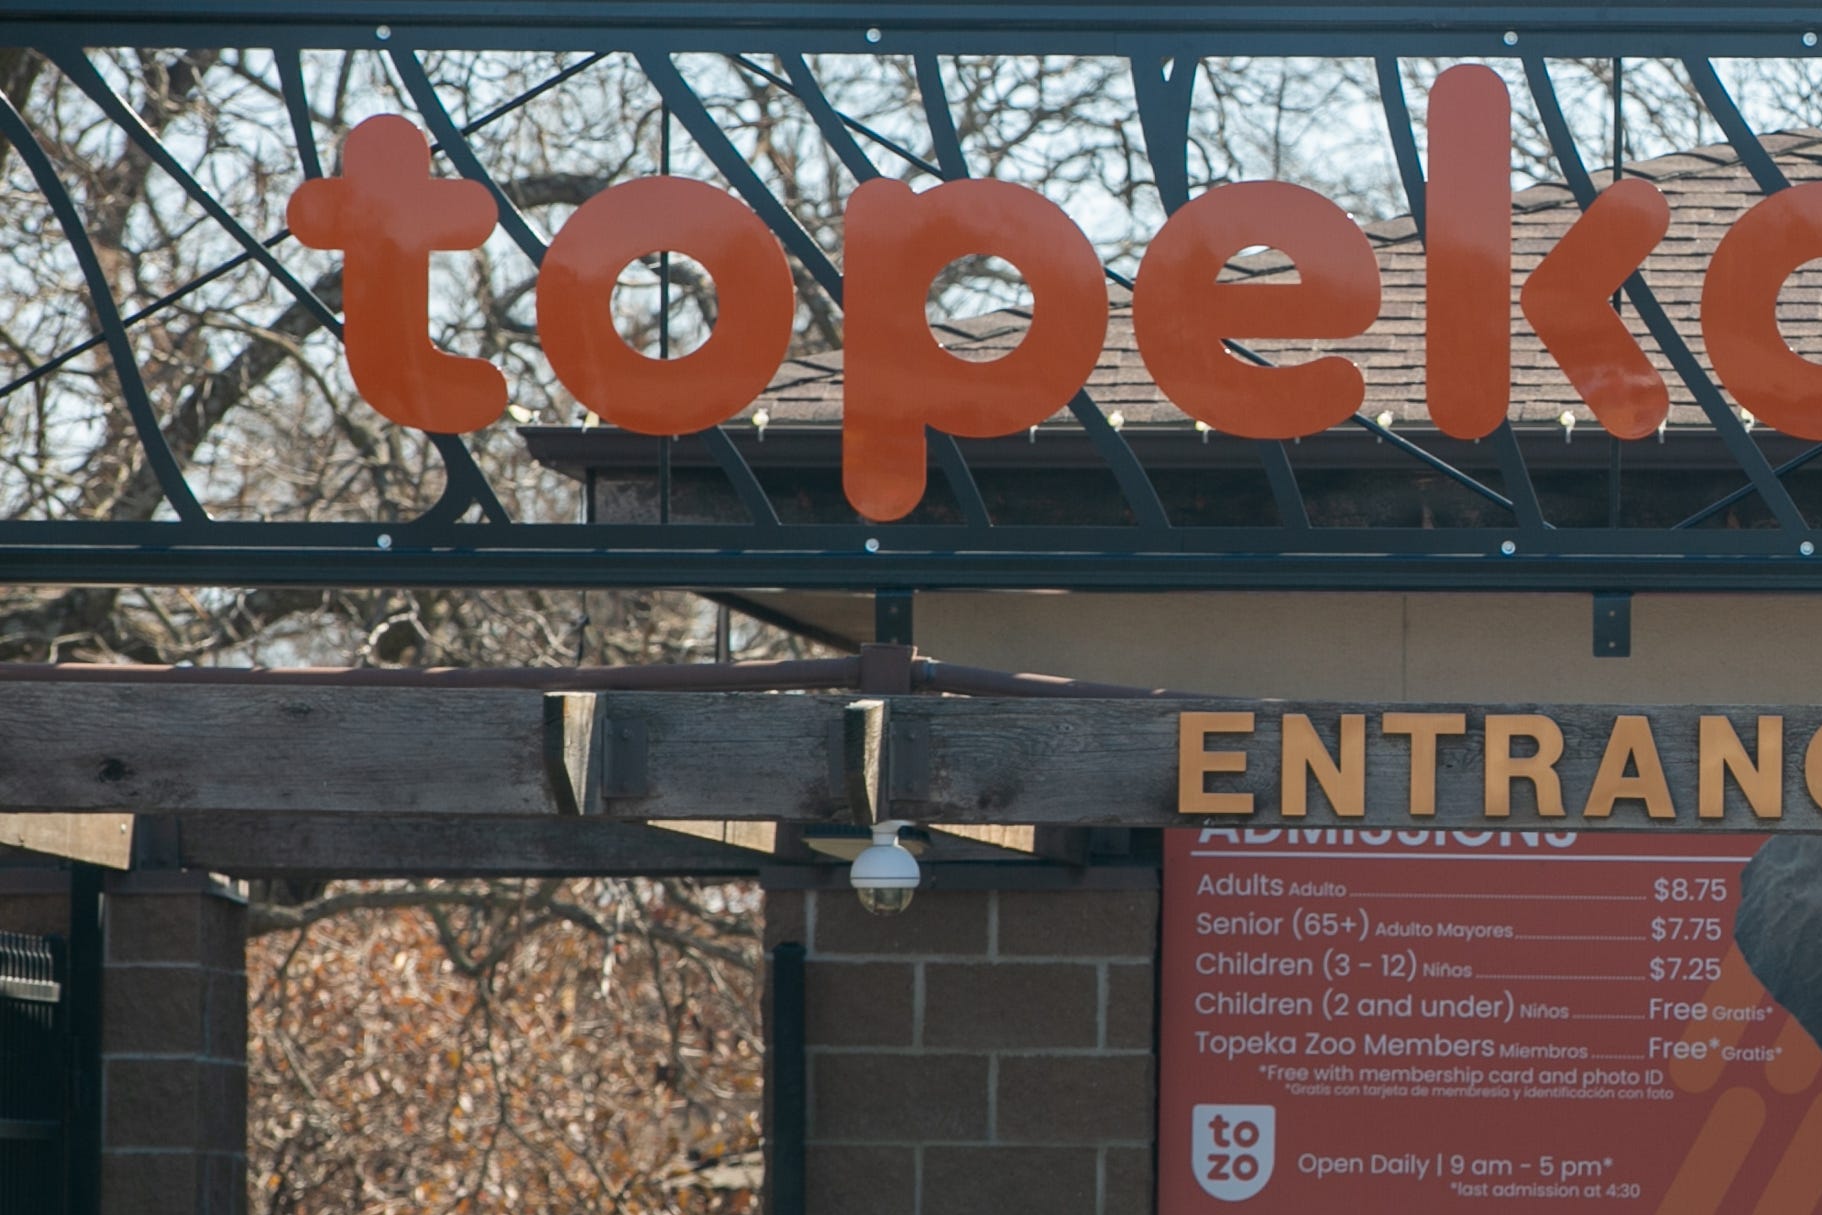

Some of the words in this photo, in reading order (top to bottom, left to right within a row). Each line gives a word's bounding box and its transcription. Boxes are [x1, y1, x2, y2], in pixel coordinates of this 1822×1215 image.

[1196, 874, 1284, 897] Adults
[1288, 882, 1347, 898] Adulto
[1653, 877, 1728, 902] $8.75
[1196, 911, 1283, 936] Senior
[1292, 907, 1369, 941] (65+)
[1374, 921, 1432, 938] Adulto
[1436, 922, 1514, 942] Mayores
[1651, 916, 1722, 942] $7.75
[1195, 952, 1313, 976] Children
[1323, 948, 1351, 981] (3
[1381, 949, 1417, 982] 12)
[1423, 961, 1473, 979] Niños
[1650, 956, 1722, 981] $7.25
[1195, 992, 1312, 1016] Children
[1322, 987, 1350, 1021] (2
[1357, 994, 1412, 1018] and
[1421, 989, 1514, 1023] under)
[1519, 1002, 1570, 1020] Niños
[1649, 998, 1708, 1021] Free
[1195, 1031, 1297, 1060] Topeka
[1304, 1032, 1356, 1056] Zoo
[1364, 1033, 1495, 1058] Members
[1499, 1042, 1588, 1060] Miembros
[1313, 1065, 1354, 1082] with
[1358, 1066, 1484, 1086] membership
[1488, 1067, 1534, 1084] card
[1538, 1068, 1578, 1085] and
[1582, 1069, 1641, 1088] photo
[1644, 1069, 1664, 1085] ID
[1334, 1086, 1361, 1096] con
[1363, 1084, 1408, 1099] tarjeta
[1411, 1085, 1429, 1097] de
[1513, 1088, 1521, 1100] y
[1618, 1089, 1644, 1099] con
[1646, 1087, 1675, 1100] foto
[1208, 1114, 1260, 1148] to
[1207, 1153, 1260, 1181] zo
[1297, 1153, 1364, 1179] Open
[1371, 1153, 1431, 1181] Daily
[1450, 1155, 1465, 1175] 9
[1471, 1158, 1513, 1176] am
[1539, 1156, 1554, 1176] 5
[1492, 1183, 1580, 1198] admission
[1583, 1184, 1602, 1198] at
[1606, 1184, 1641, 1198] 4:30
